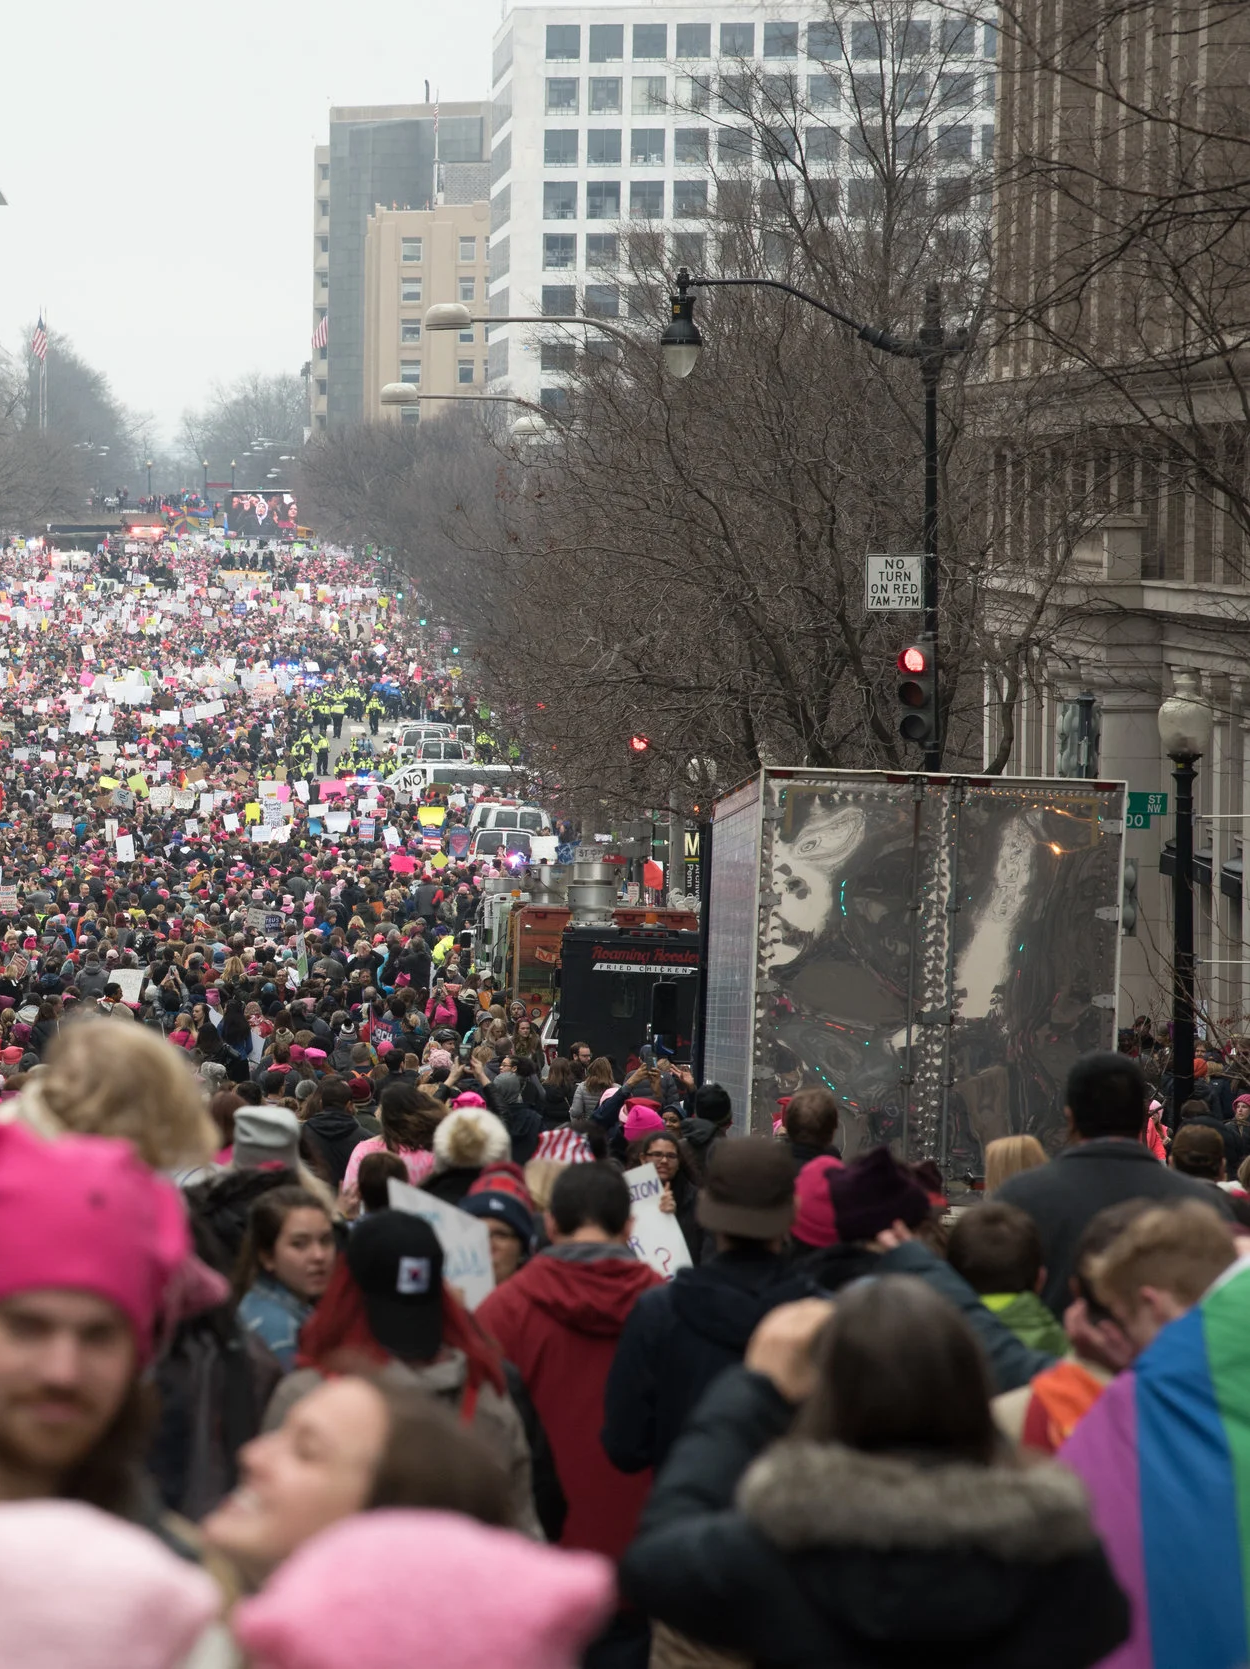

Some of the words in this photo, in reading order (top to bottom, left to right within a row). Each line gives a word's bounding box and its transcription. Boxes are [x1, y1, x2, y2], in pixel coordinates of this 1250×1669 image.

[885, 559, 905, 570] NO
[878, 571, 911, 582] TURN
[871, 583, 888, 594] ON
[893, 583, 918, 594] RED
[870, 595, 919, 606] 7AM-7PM
[403, 774, 422, 788] NO
[1148, 794, 1162, 804] ST
[1147, 804, 1162, 813] NW
[591, 945, 651, 964] Roaming
[639, 965, 688, 974] CHICKEN
